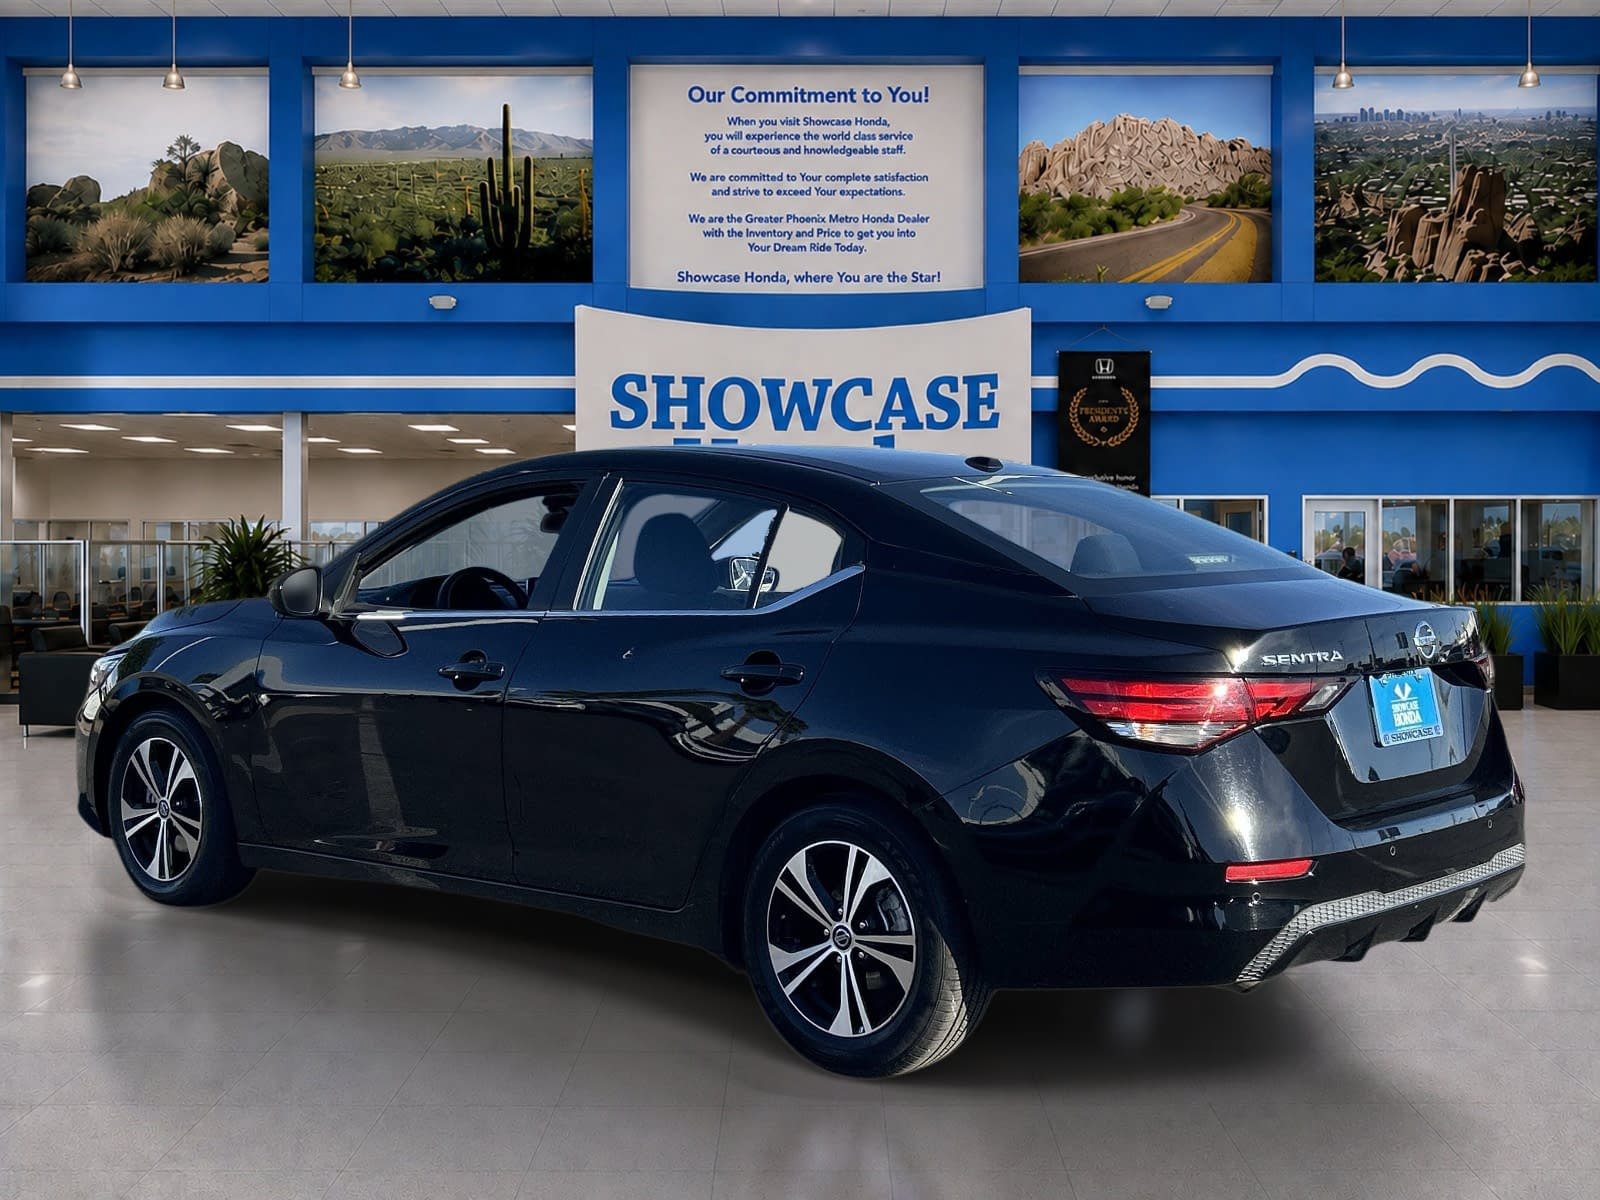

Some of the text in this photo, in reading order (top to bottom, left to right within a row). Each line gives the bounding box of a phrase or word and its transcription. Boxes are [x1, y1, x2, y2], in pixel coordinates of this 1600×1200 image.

[687, 86, 929, 103] Our Commitment to You!
[726, 116, 890, 128] When you visit Showcase Honda,
[704, 131, 913, 143] you will experience the world class service
[709, 145, 721, 154] of
[730, 147, 781, 155] courteous
[782, 145, 801, 154] and
[881, 145, 906, 154] staff.
[689, 173, 707, 182] We
[727, 172, 783, 182] committed
[785, 174, 797, 182] to
[799, 173, 822, 182] Your
[824, 172, 871, 184] complete
[873, 172, 928, 182] satisfaction
[711, 187, 905, 199] and strive to exceed Your expectations.
[687, 214, 705, 223] We
[725, 214, 743, 223] the
[744, 214, 784, 223] Greater
[785, 214, 826, 223] Phoenix
[828, 214, 859, 223] Metro
[861, 214, 895, 223] Honda
[896, 214, 930, 223] Dealer
[702, 228, 916, 240] with the Inventory and Price to get you into
[747, 243, 867, 254] Your Dream Ride Today.
[676, 271, 940, 285] Showcase Honda, where You are the Star!
[610, 373, 1000, 431] SHOWCASE
[1262, 649, 1344, 667] SENTRA
[1391, 700, 1420, 713] SHOWCASE
[1393, 710, 1423, 728] HONDA
[1390, 727, 1434, 743] SHOWCASE
